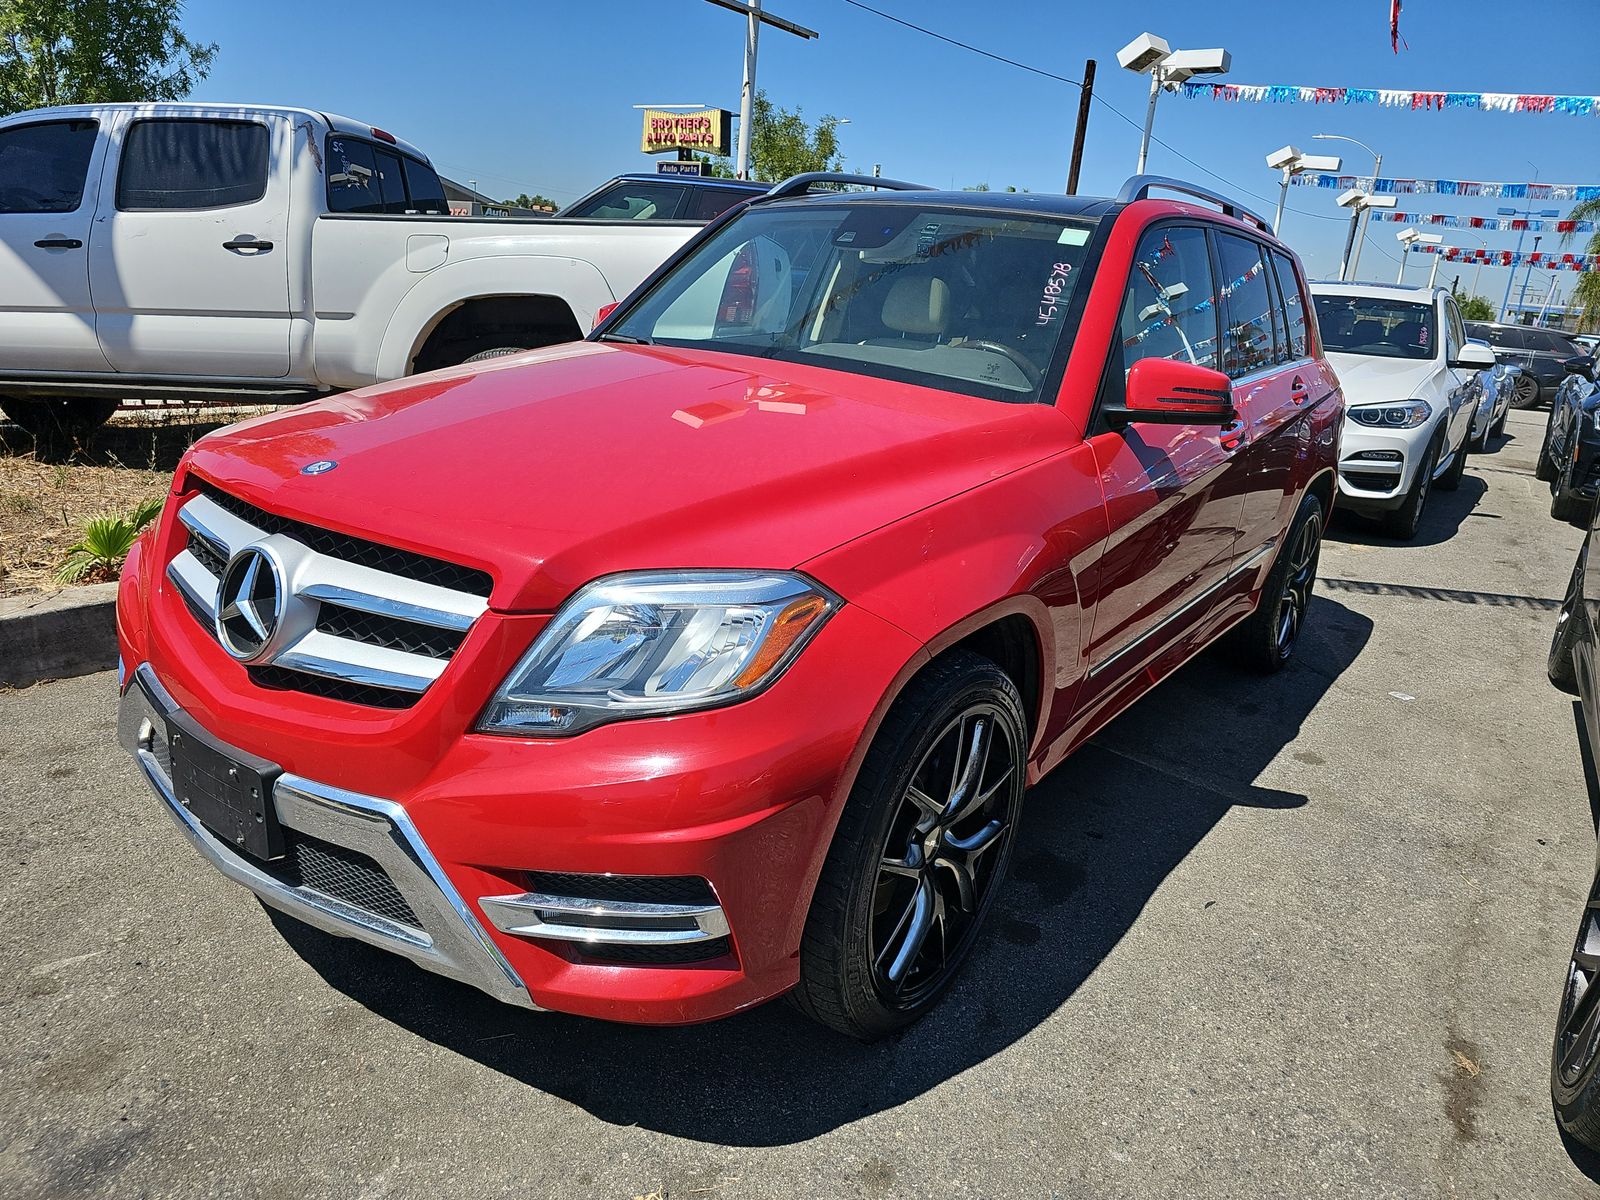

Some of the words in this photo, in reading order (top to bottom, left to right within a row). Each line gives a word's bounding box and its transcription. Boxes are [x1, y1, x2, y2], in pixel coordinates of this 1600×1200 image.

[651, 116, 711, 129] BROTHER'S
[647, 132, 676, 144] AUTO
[678, 132, 714, 145] PARTS
[661, 164, 678, 173] Auto
[679, 164, 698, 173] Parts
[1035, 262, 1072, 325] 4548578
